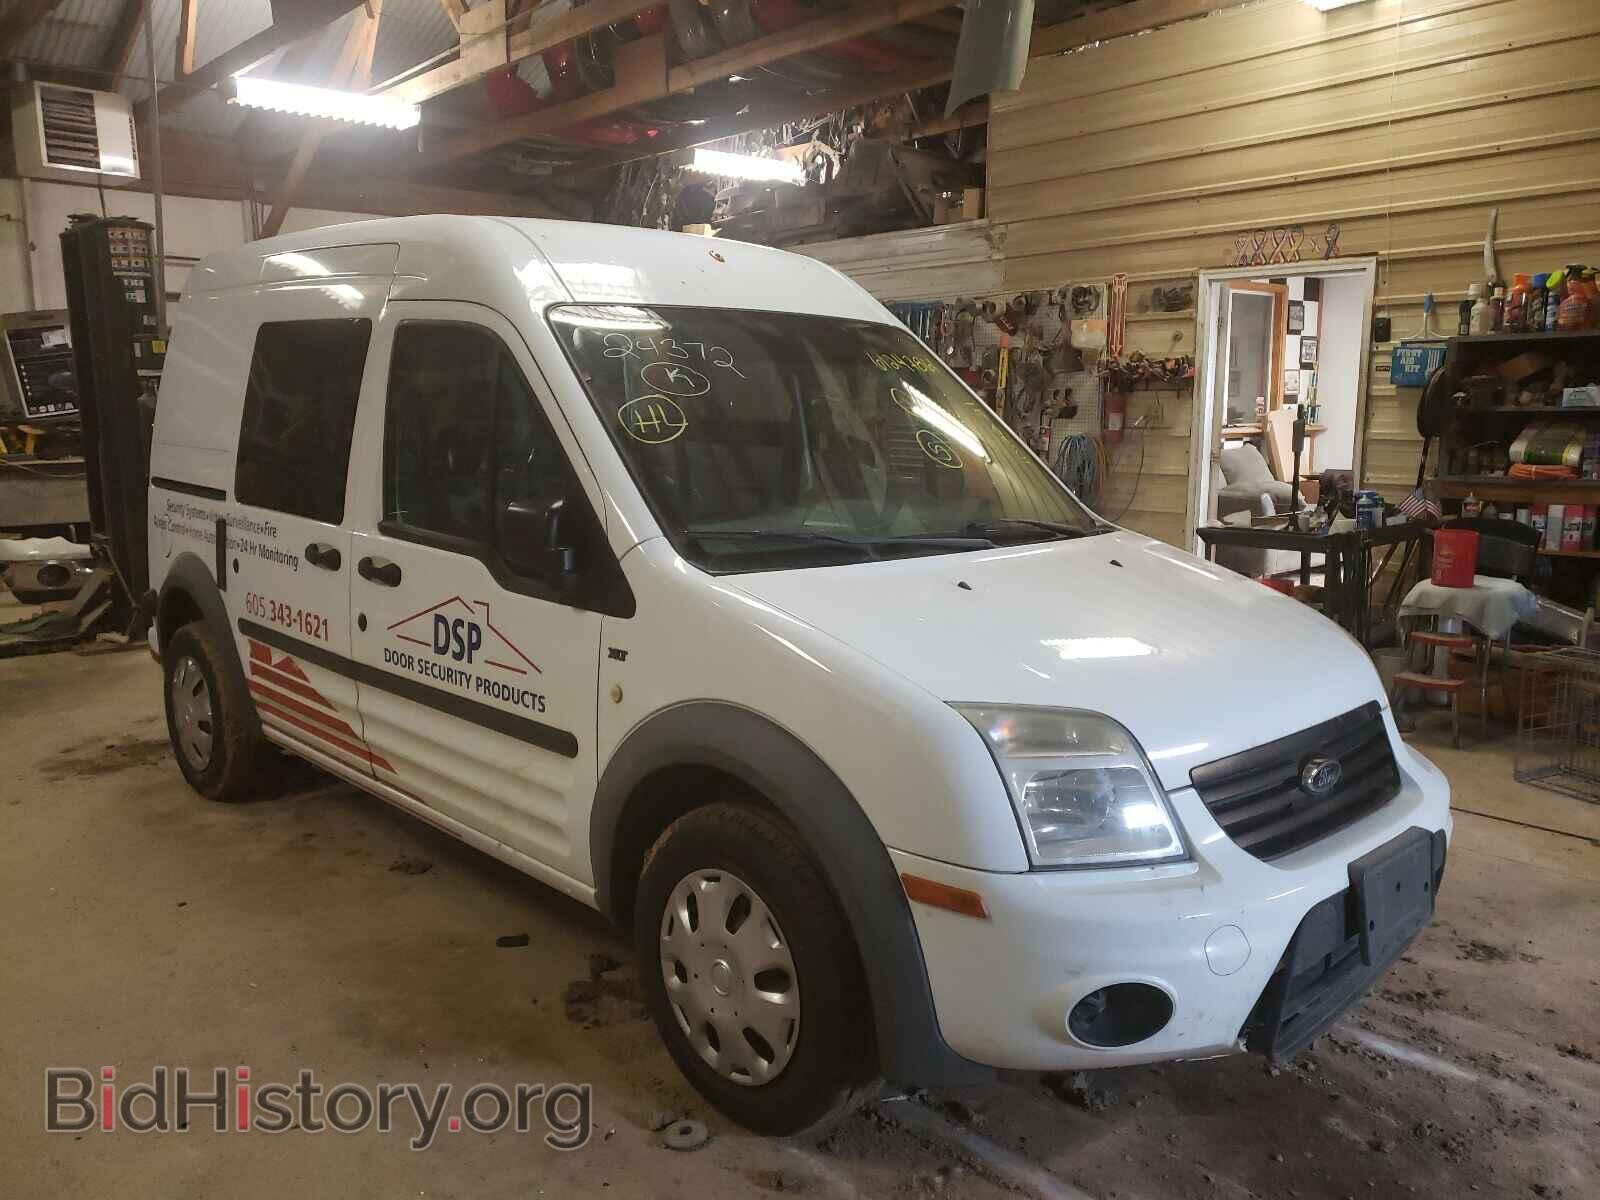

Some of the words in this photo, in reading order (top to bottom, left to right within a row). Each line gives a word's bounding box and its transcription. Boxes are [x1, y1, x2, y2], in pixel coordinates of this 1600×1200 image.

[603, 333, 747, 379] 24372
[258, 543, 299, 572] Monitoring
[433, 613, 482, 665] DSP
[384, 647, 415, 672] DOOR
[417, 658, 473, 690] SECURITY
[475, 676, 546, 713] PRODUCTS
